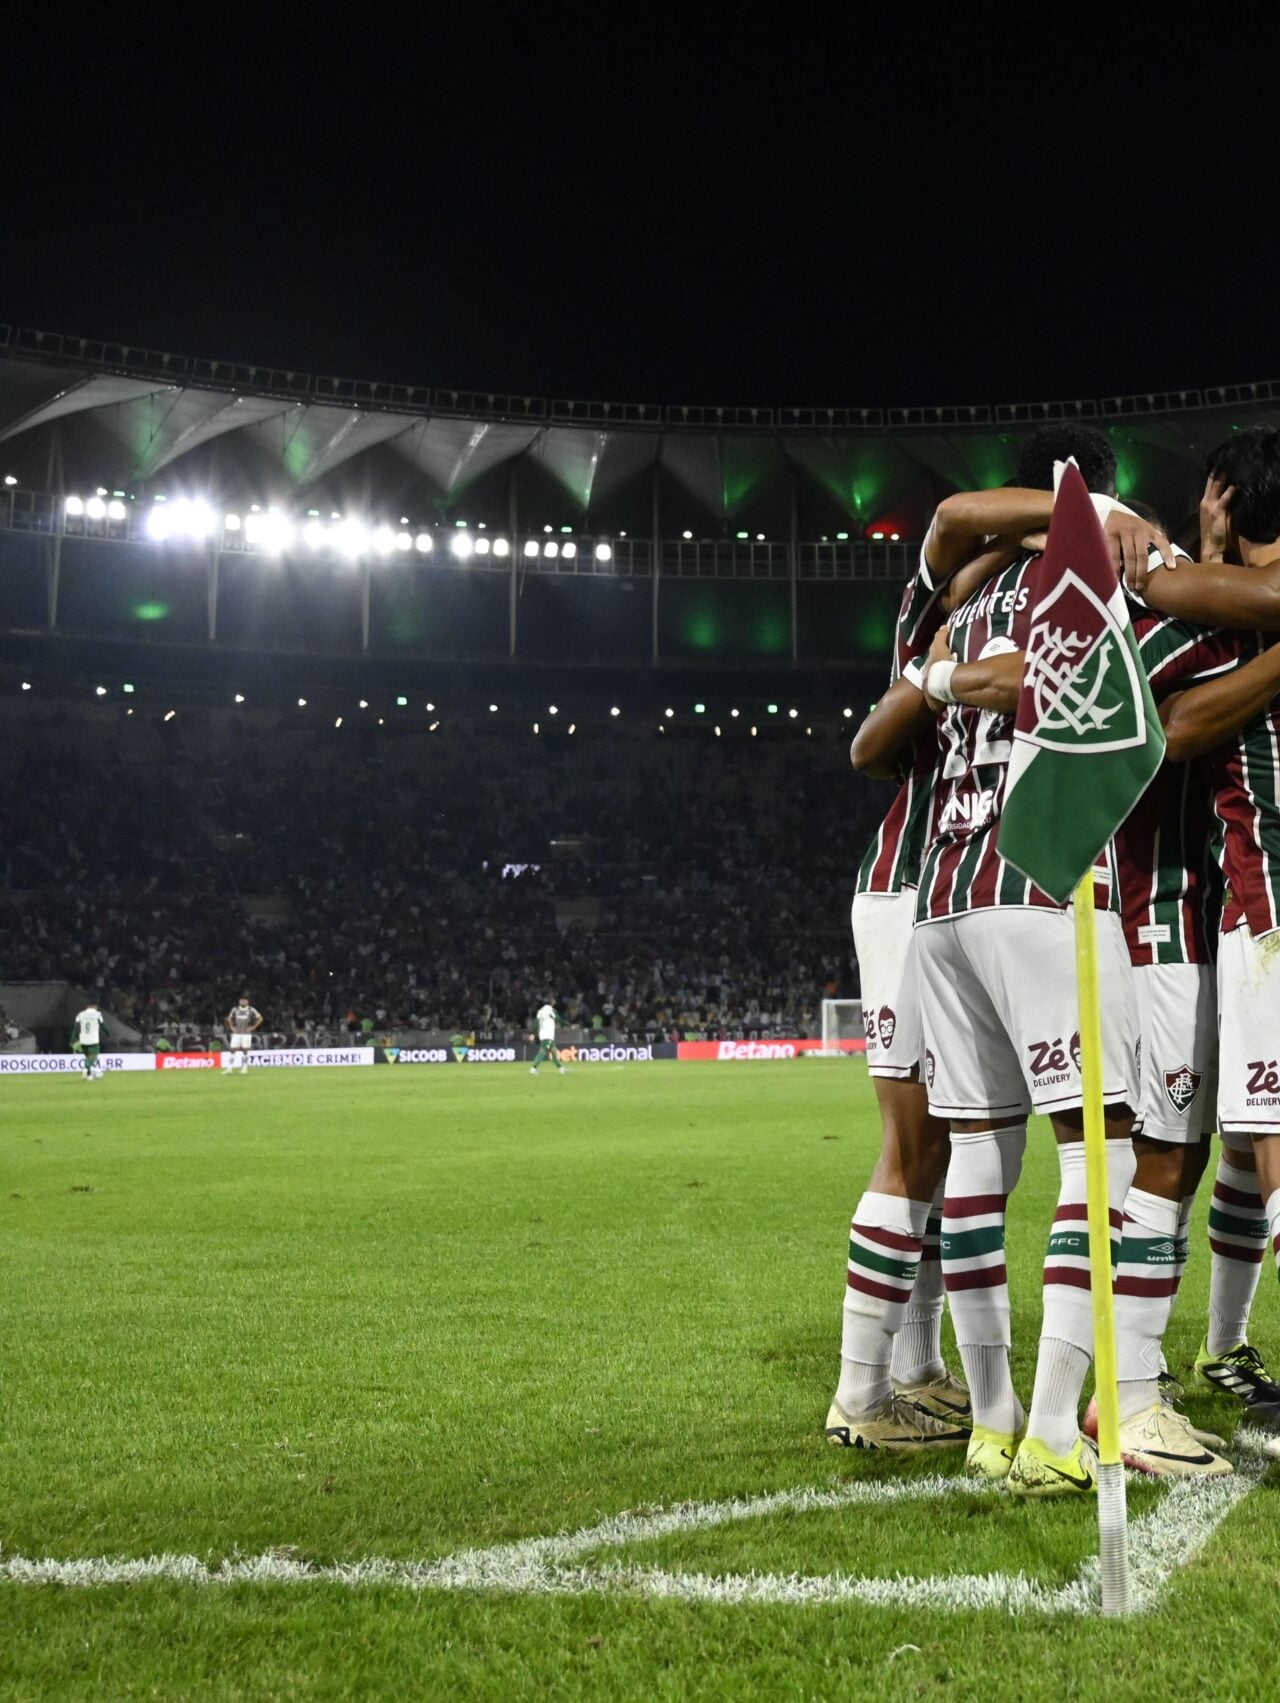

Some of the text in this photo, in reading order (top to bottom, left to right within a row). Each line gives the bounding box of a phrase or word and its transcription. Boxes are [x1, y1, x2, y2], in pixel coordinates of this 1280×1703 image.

[399, 1048, 515, 1062] SICOOB SICOOB
[553, 1044, 653, 1061] etnacional
[717, 1041, 795, 1060] Betano
[1028, 1037, 1069, 1076] Zé
[163, 1056, 214, 1069] Betano
[316, 1053, 361, 1064] CRIME!
[1033, 1073, 1071, 1087] DELIVERY
[1050, 1237, 1080, 1247] FFC
